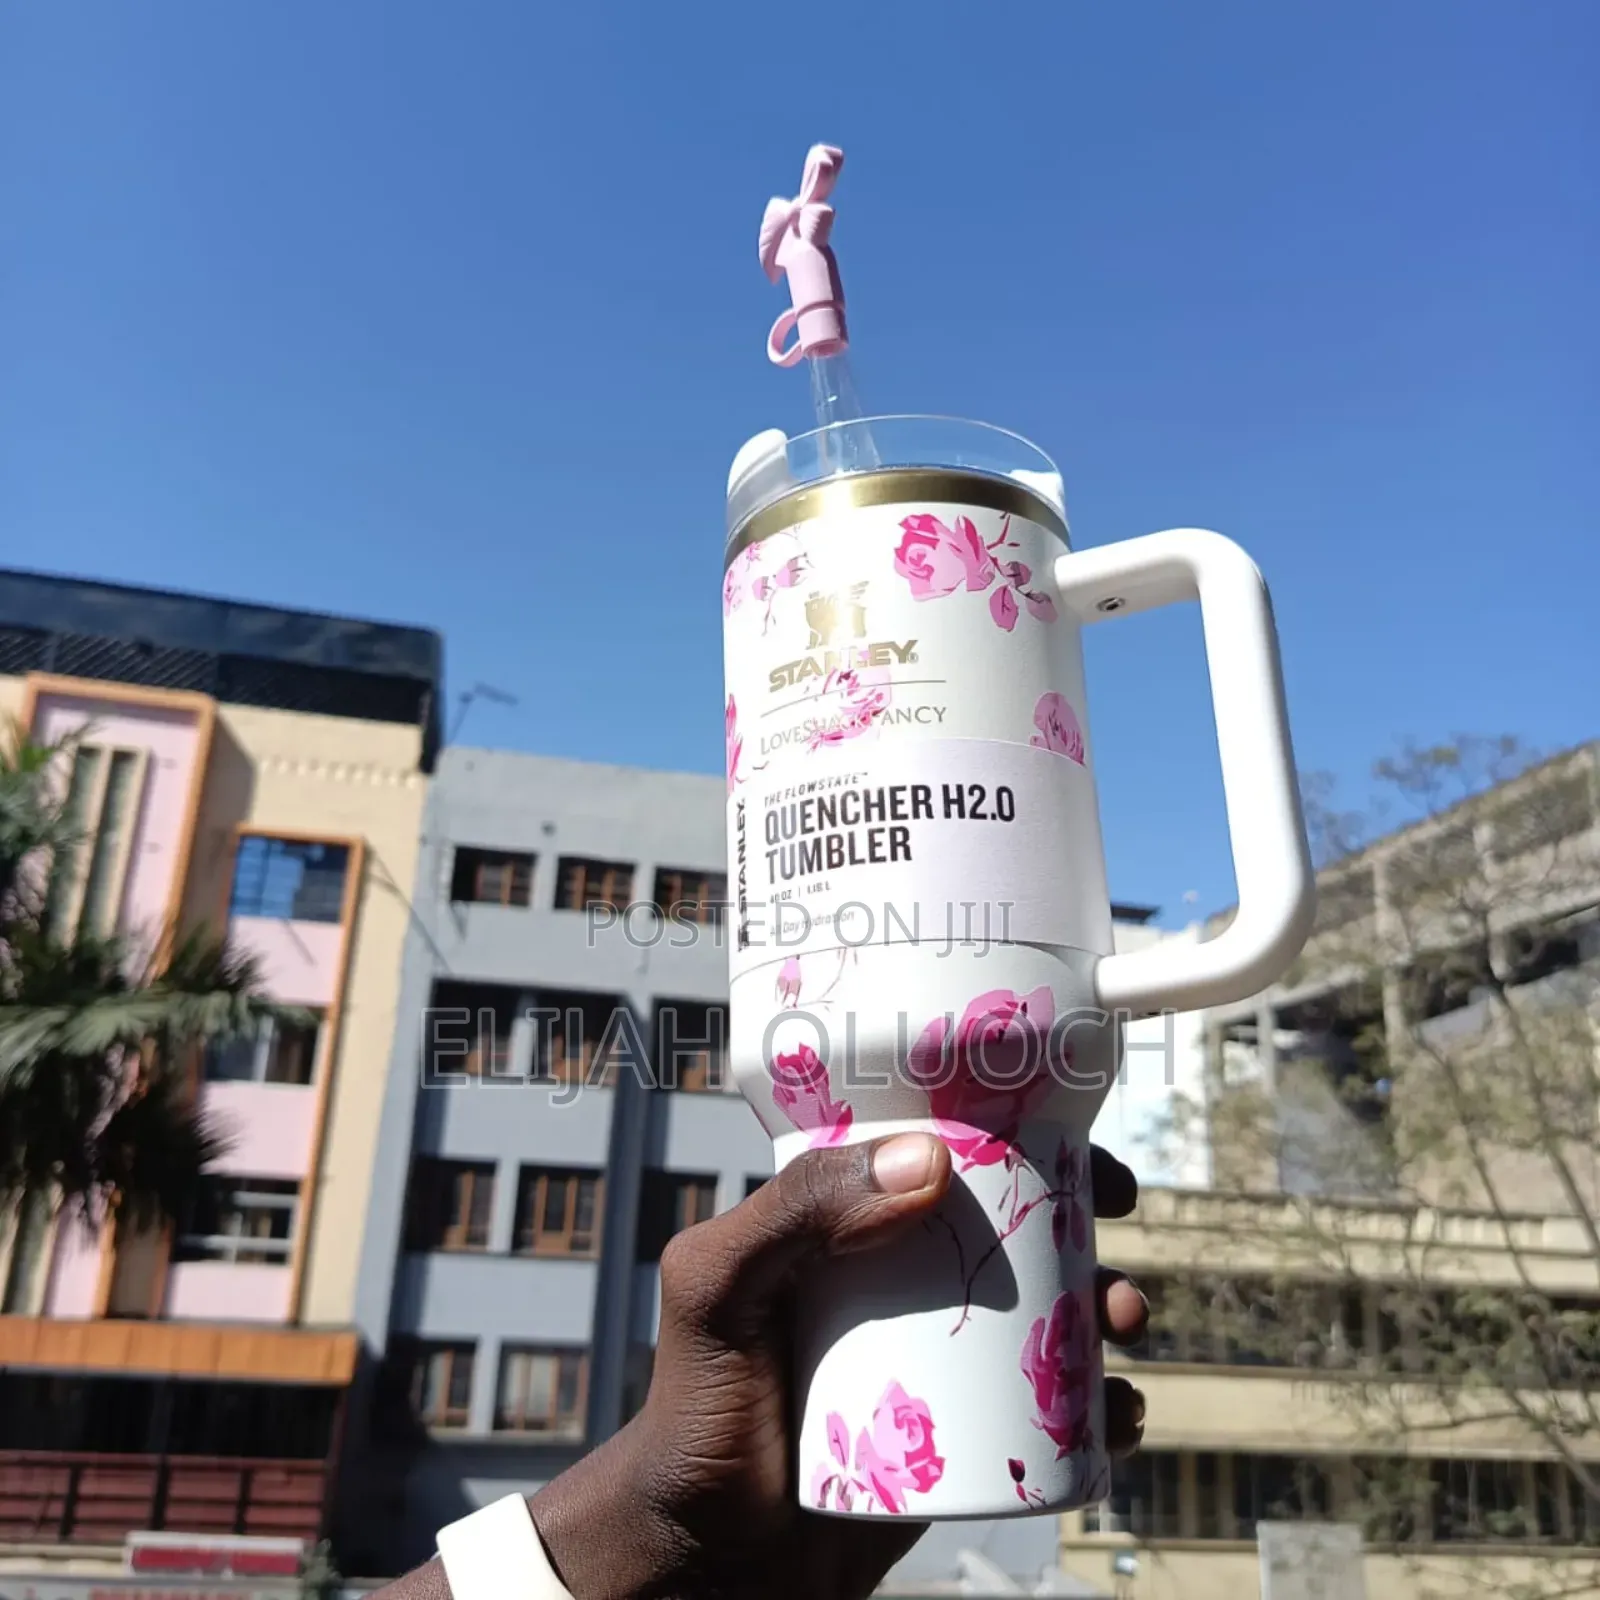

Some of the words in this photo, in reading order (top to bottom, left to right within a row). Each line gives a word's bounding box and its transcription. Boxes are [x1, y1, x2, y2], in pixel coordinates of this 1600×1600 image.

[764, 791, 781, 808] THE
[765, 784, 935, 846] QUENCHER
[941, 783, 1015, 822] H2.0
[765, 825, 912, 885] TUMBLER
